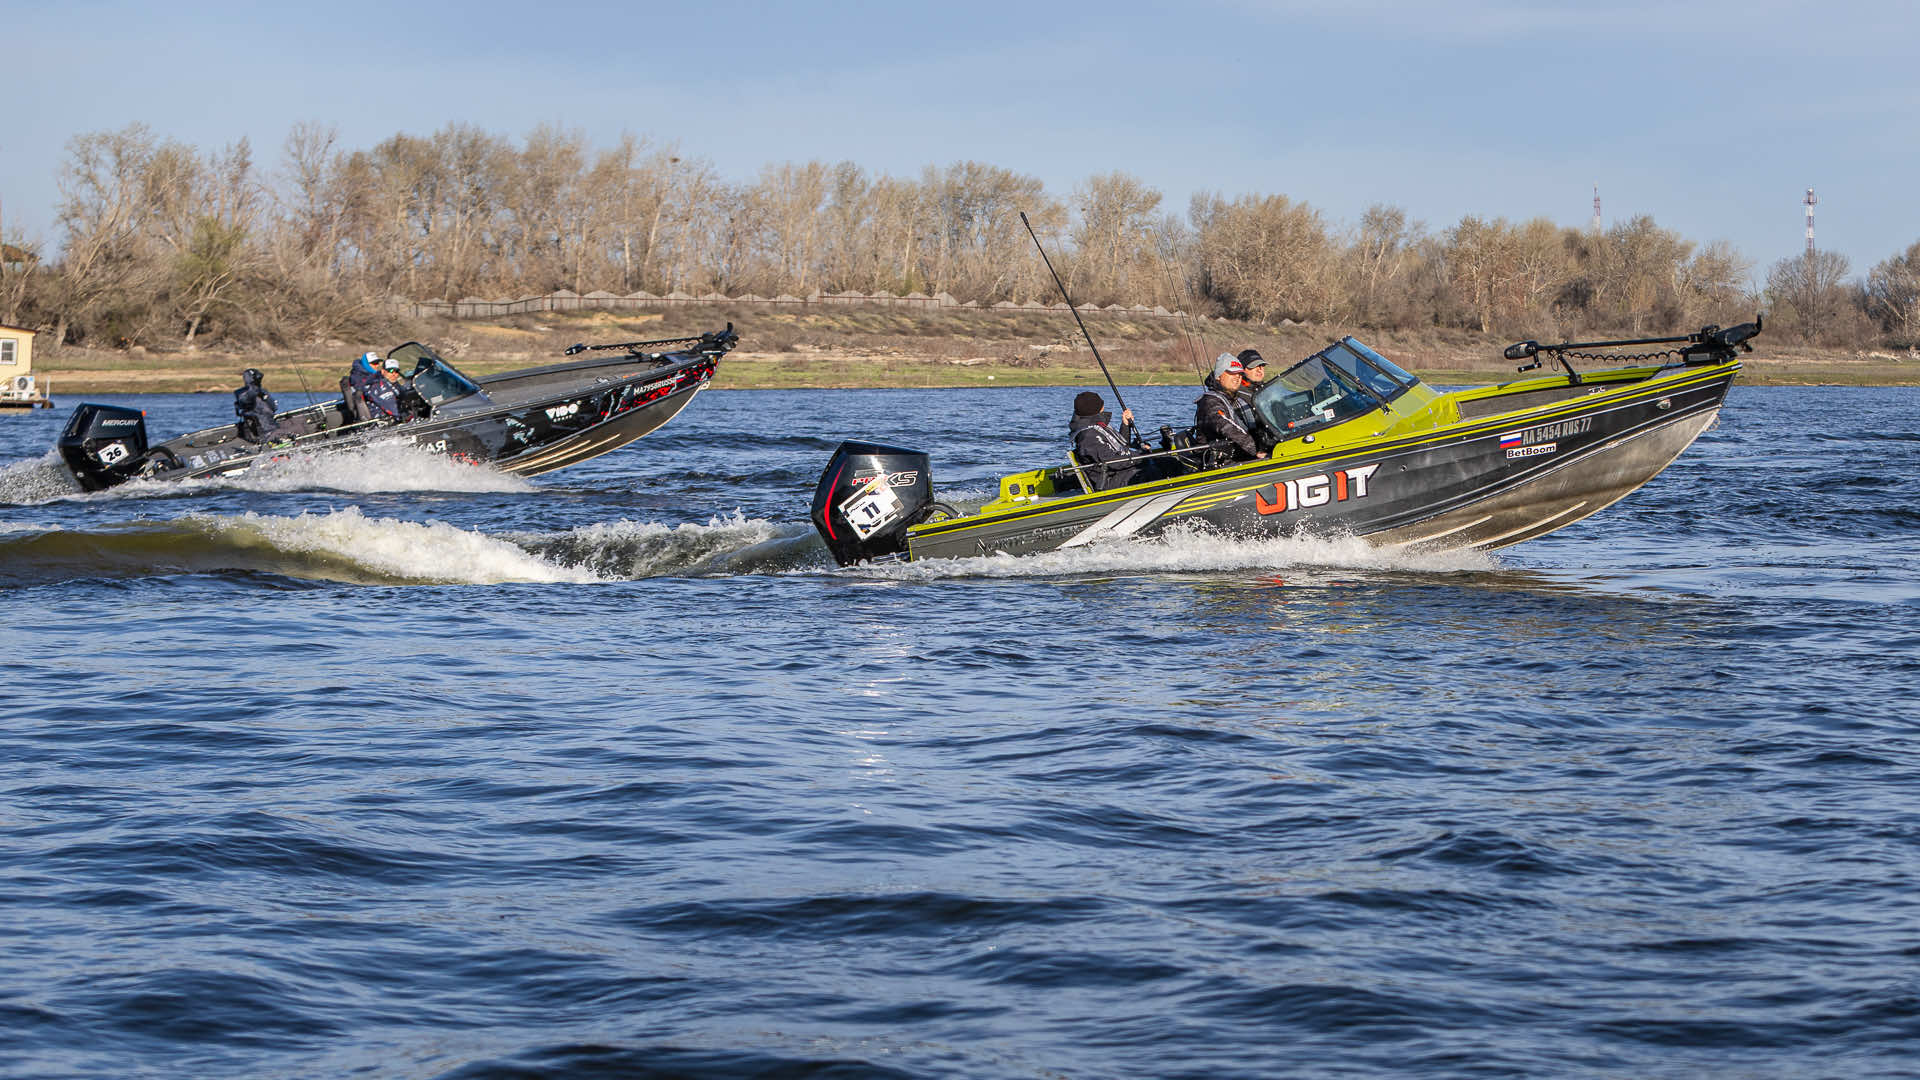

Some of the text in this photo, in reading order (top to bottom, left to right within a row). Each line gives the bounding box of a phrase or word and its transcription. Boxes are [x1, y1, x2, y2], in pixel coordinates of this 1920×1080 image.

[1536, 424, 1561, 442] 5454
[1562, 419, 1580, 437] RUS
[1580, 416, 1592, 432] 77
[106, 447, 122, 461] 26
[1507, 445, 1555, 458] BetBoom
[862, 501, 880, 519] 11
